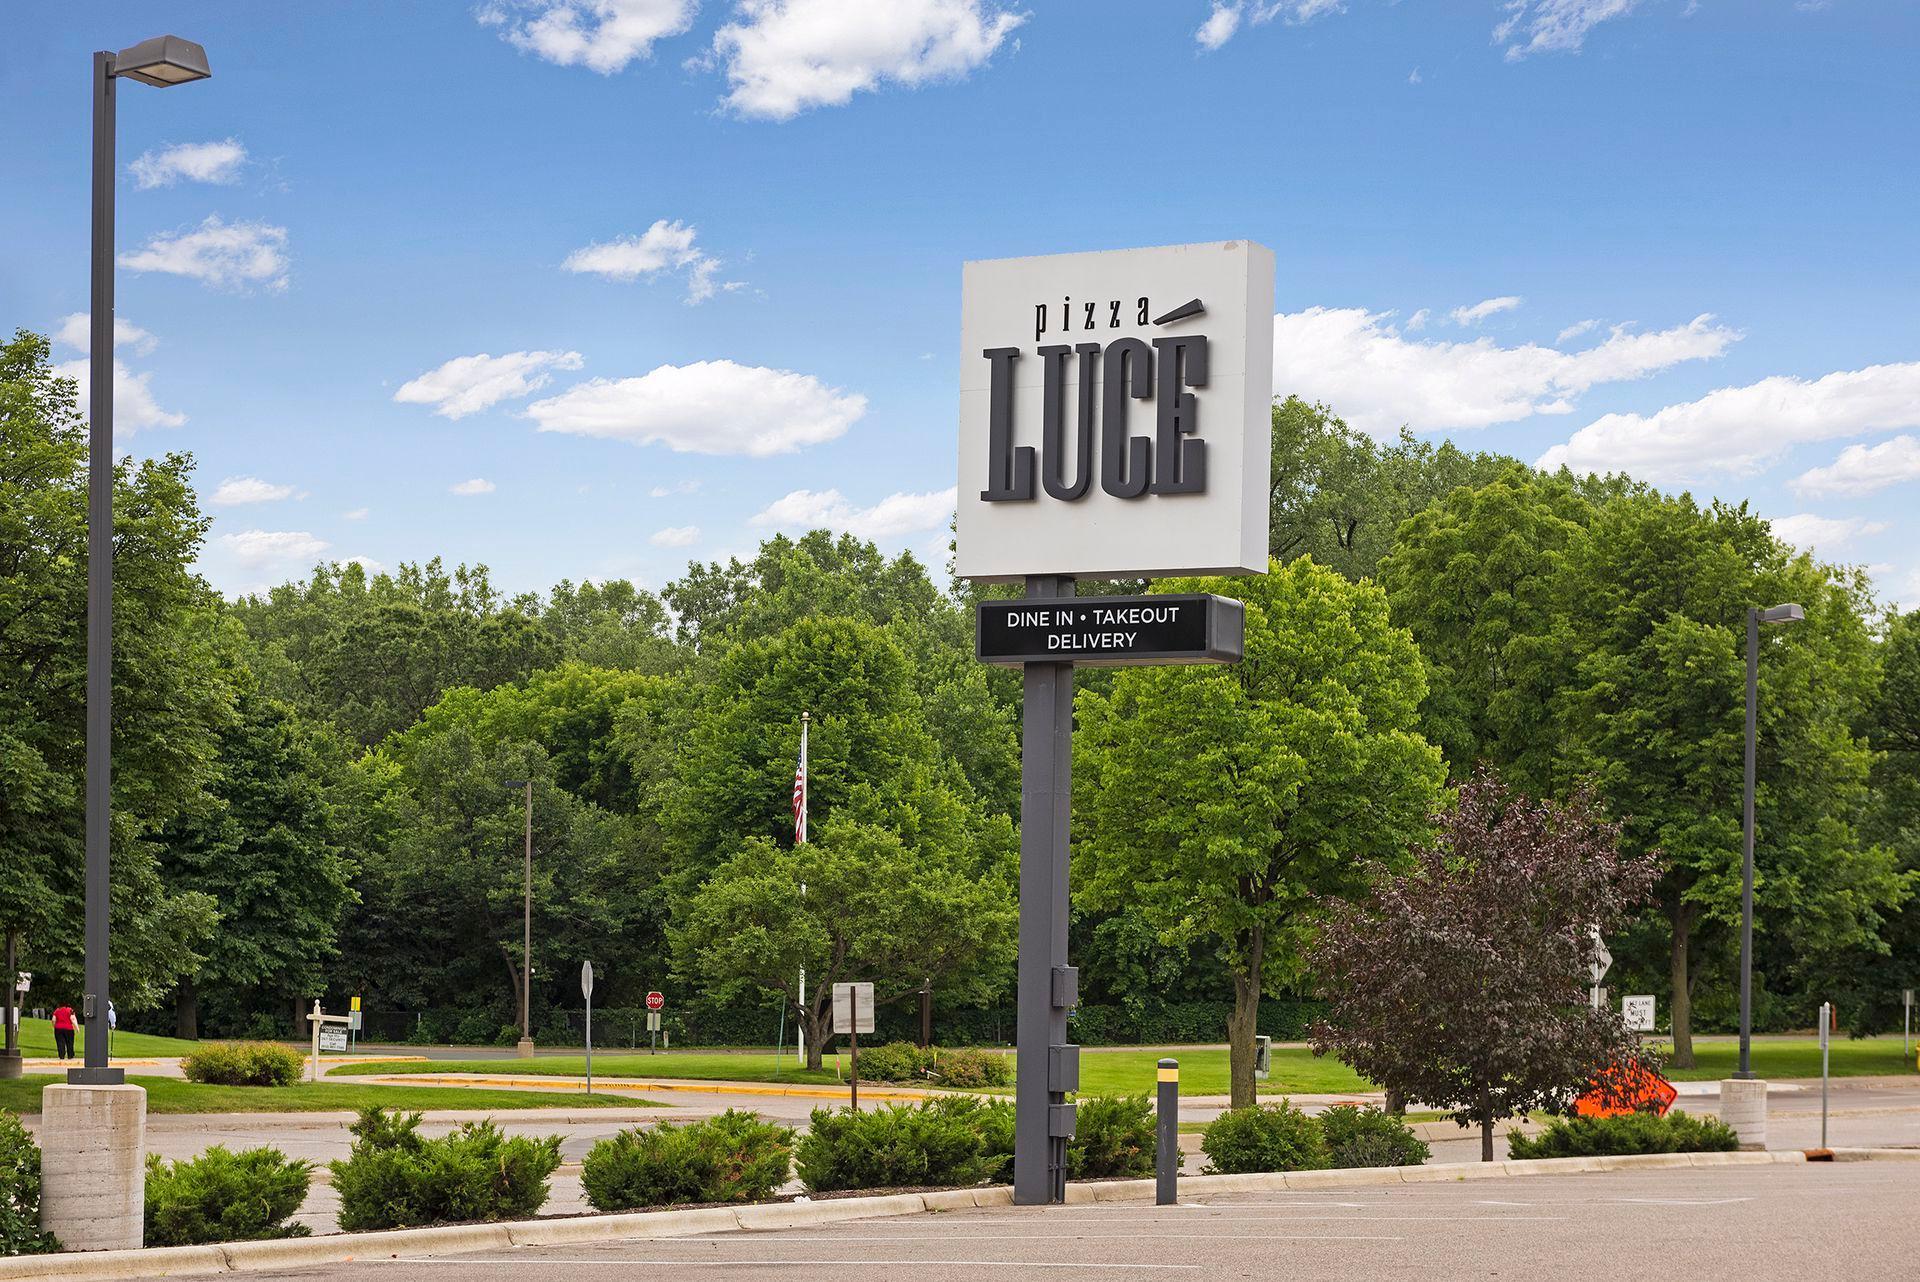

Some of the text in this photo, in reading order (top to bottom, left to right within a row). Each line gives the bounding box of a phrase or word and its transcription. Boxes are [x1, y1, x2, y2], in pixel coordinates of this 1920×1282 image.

[1035, 296, 1149, 342] pizza
[981, 298, 1208, 501] LUCÉ
[1007, 607, 1180, 627] DINE IN TAKEOUT
[1048, 632, 1137, 649] DELIVERY
[647, 997, 662, 1005] STOP
